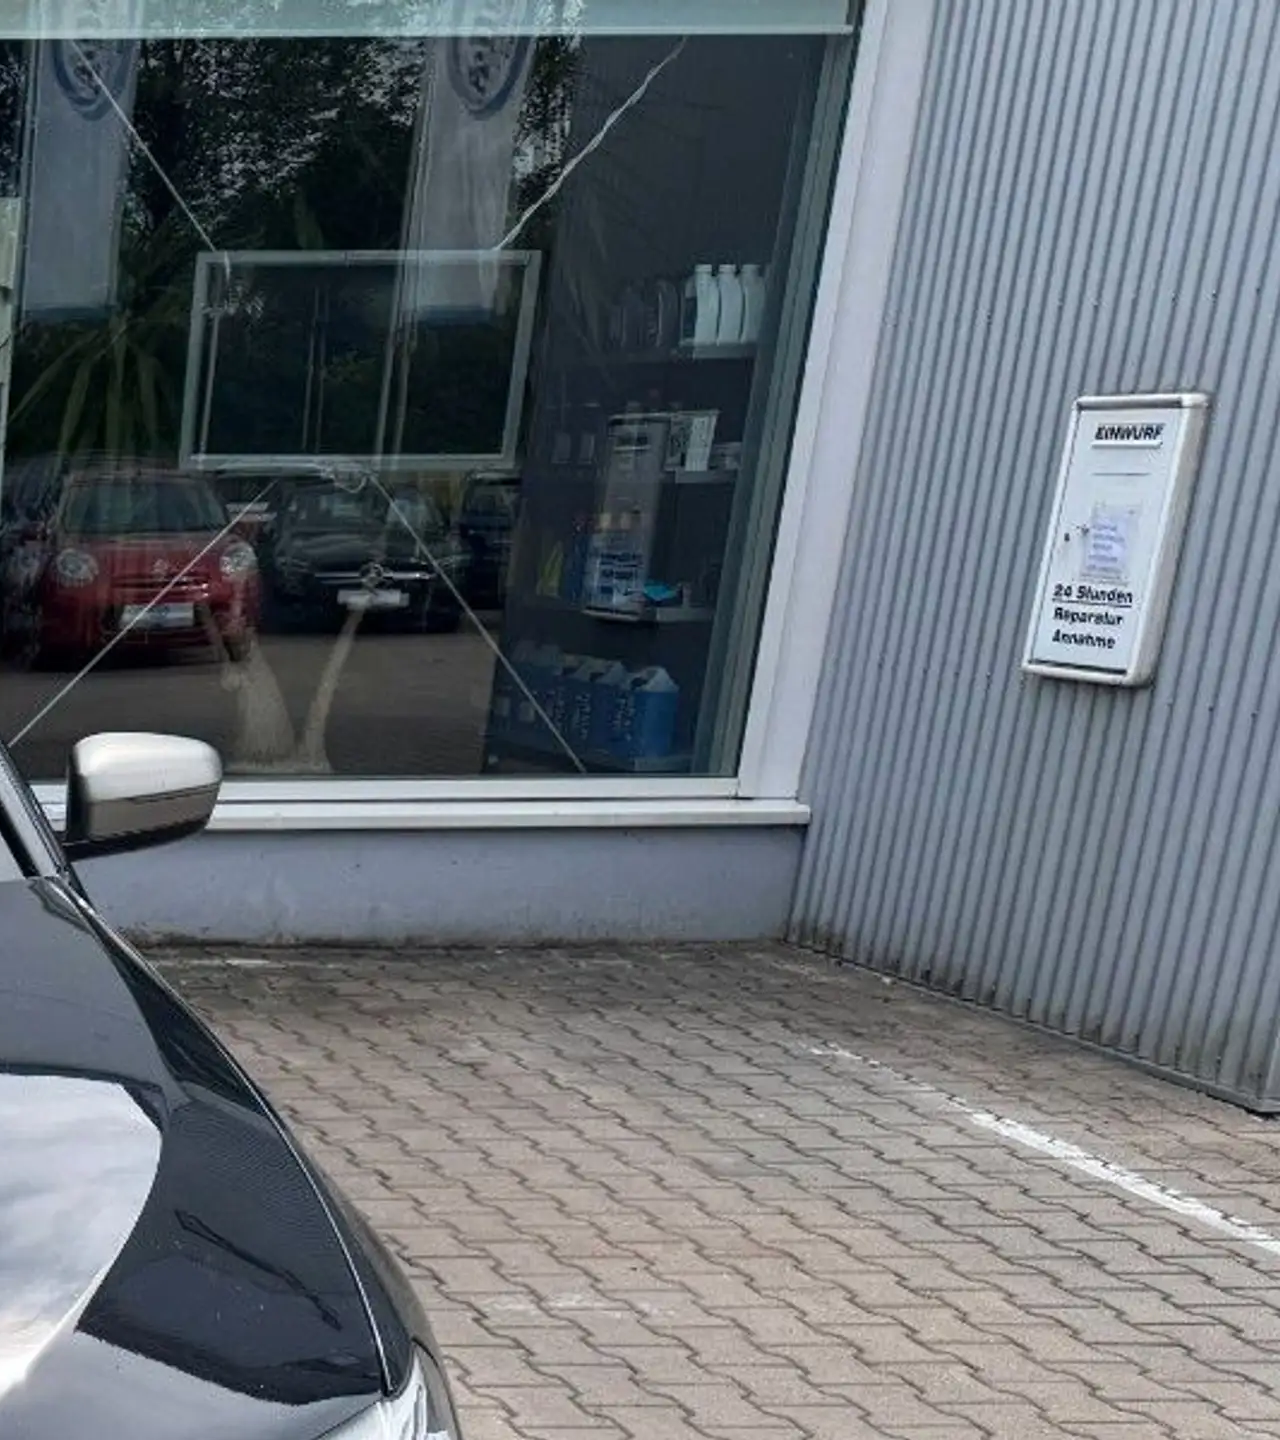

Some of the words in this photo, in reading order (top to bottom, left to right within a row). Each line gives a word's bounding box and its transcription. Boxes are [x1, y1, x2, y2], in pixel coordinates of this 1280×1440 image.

[1094, 423, 1165, 441] EINWURF
[1077, 585, 1133, 603] Stunden
[1053, 607, 1123, 626] Reparatur
[1052, 630, 1115, 649] Annahme
